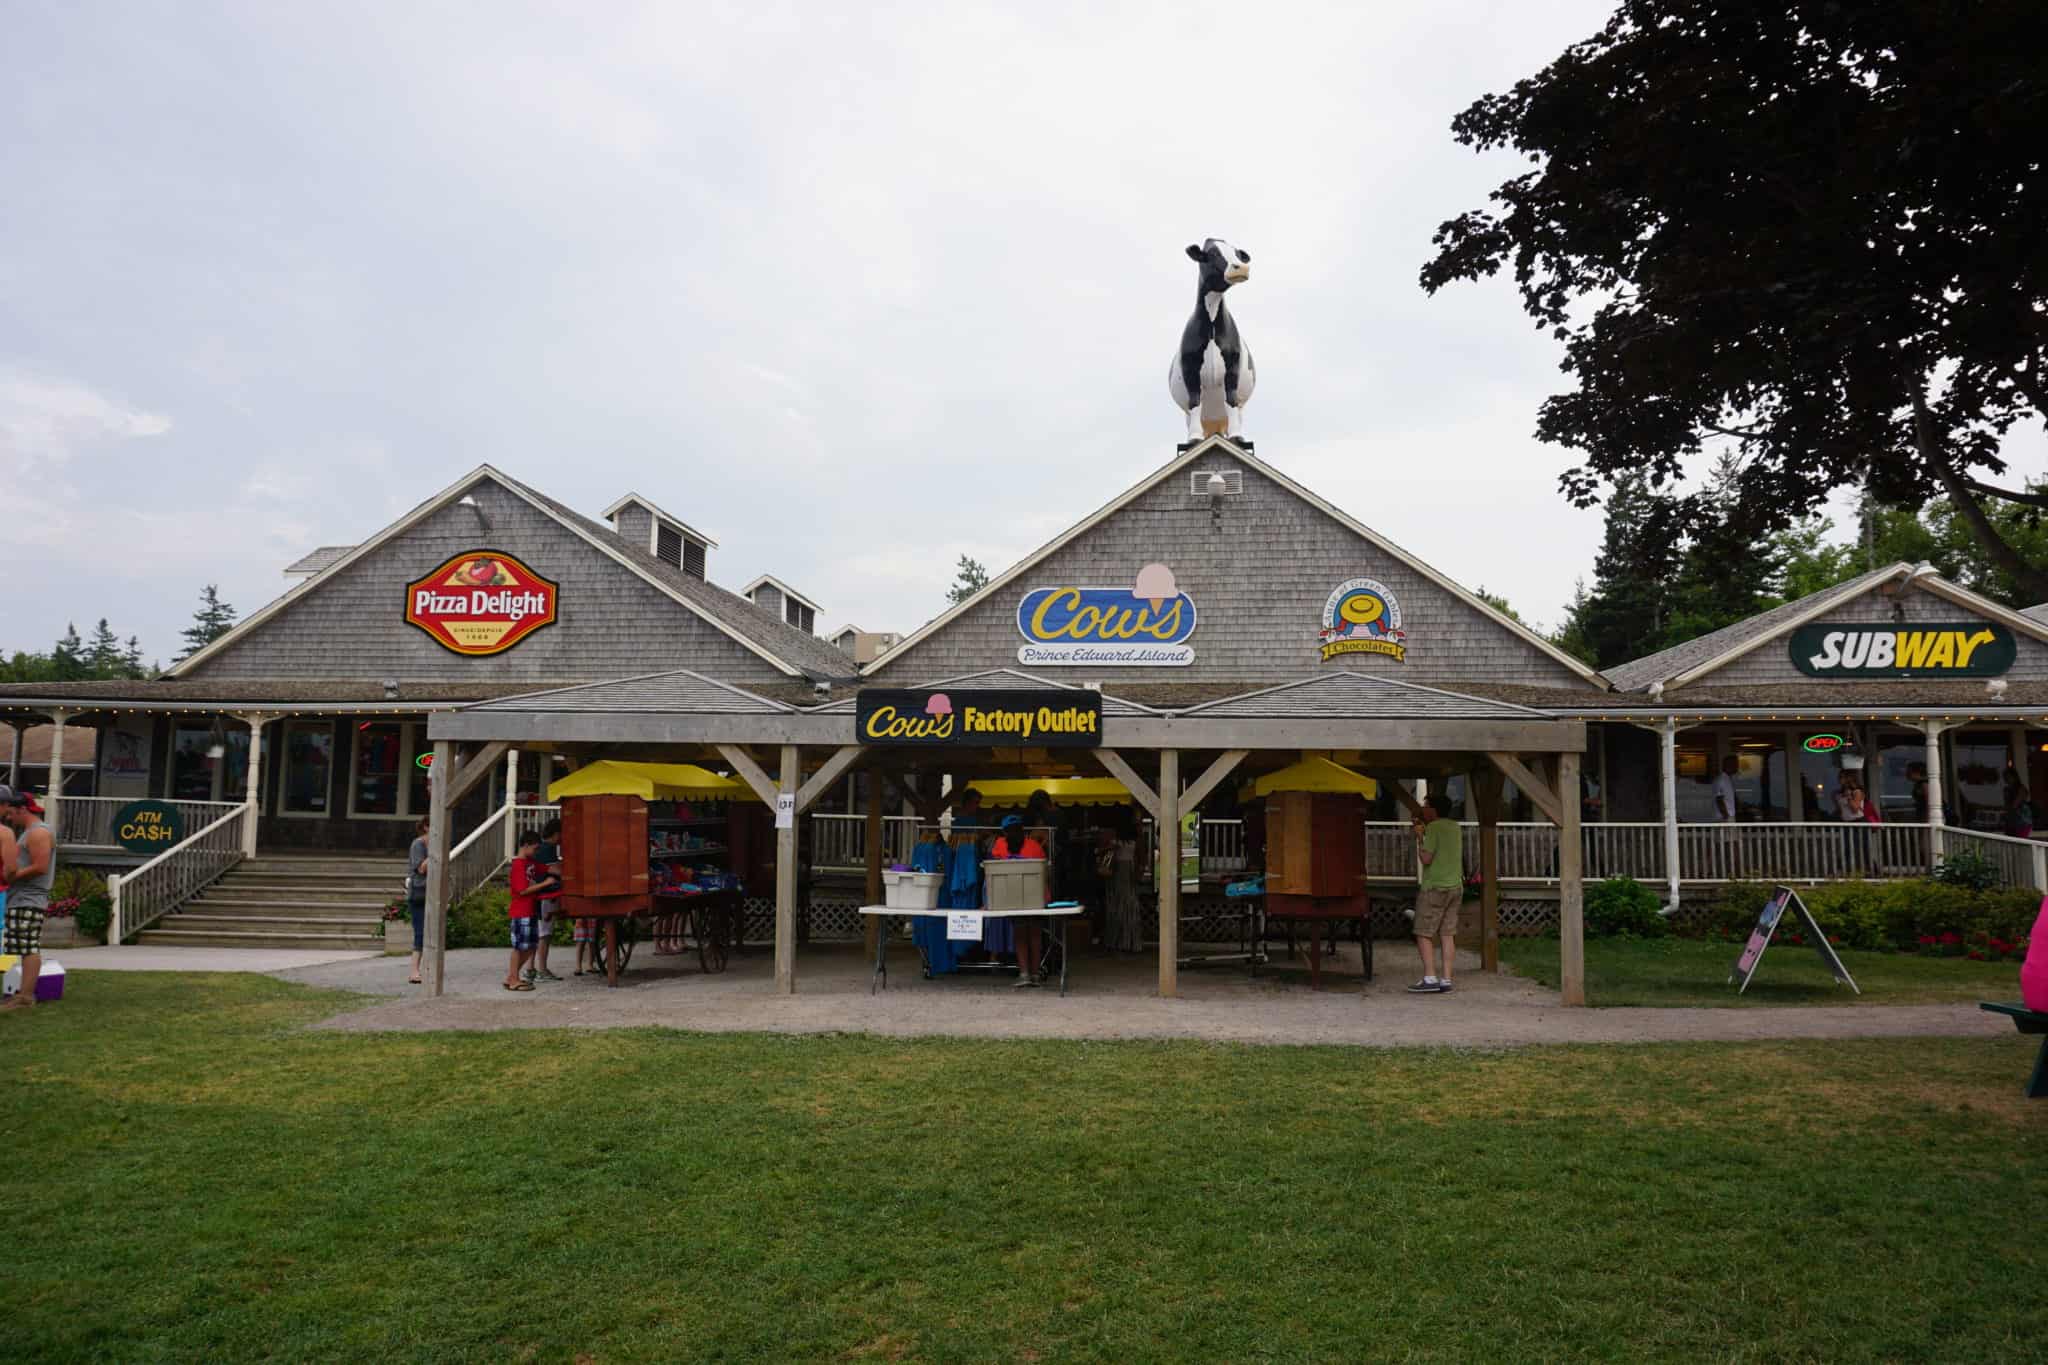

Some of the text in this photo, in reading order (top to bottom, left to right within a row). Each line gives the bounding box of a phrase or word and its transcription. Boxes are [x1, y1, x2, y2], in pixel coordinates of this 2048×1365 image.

[415, 590, 545, 620] Pizza Delight
[1023, 648, 1189, 662] Prince Edward Island
[1809, 628, 1996, 671] SUBWAY
[964, 707, 1034, 737] Factory
[1037, 707, 1097, 732] Outlet
[1807, 737, 1838, 748] OPEN
[134, 811, 163, 823] ATM
[120, 824, 172, 840] CASH
